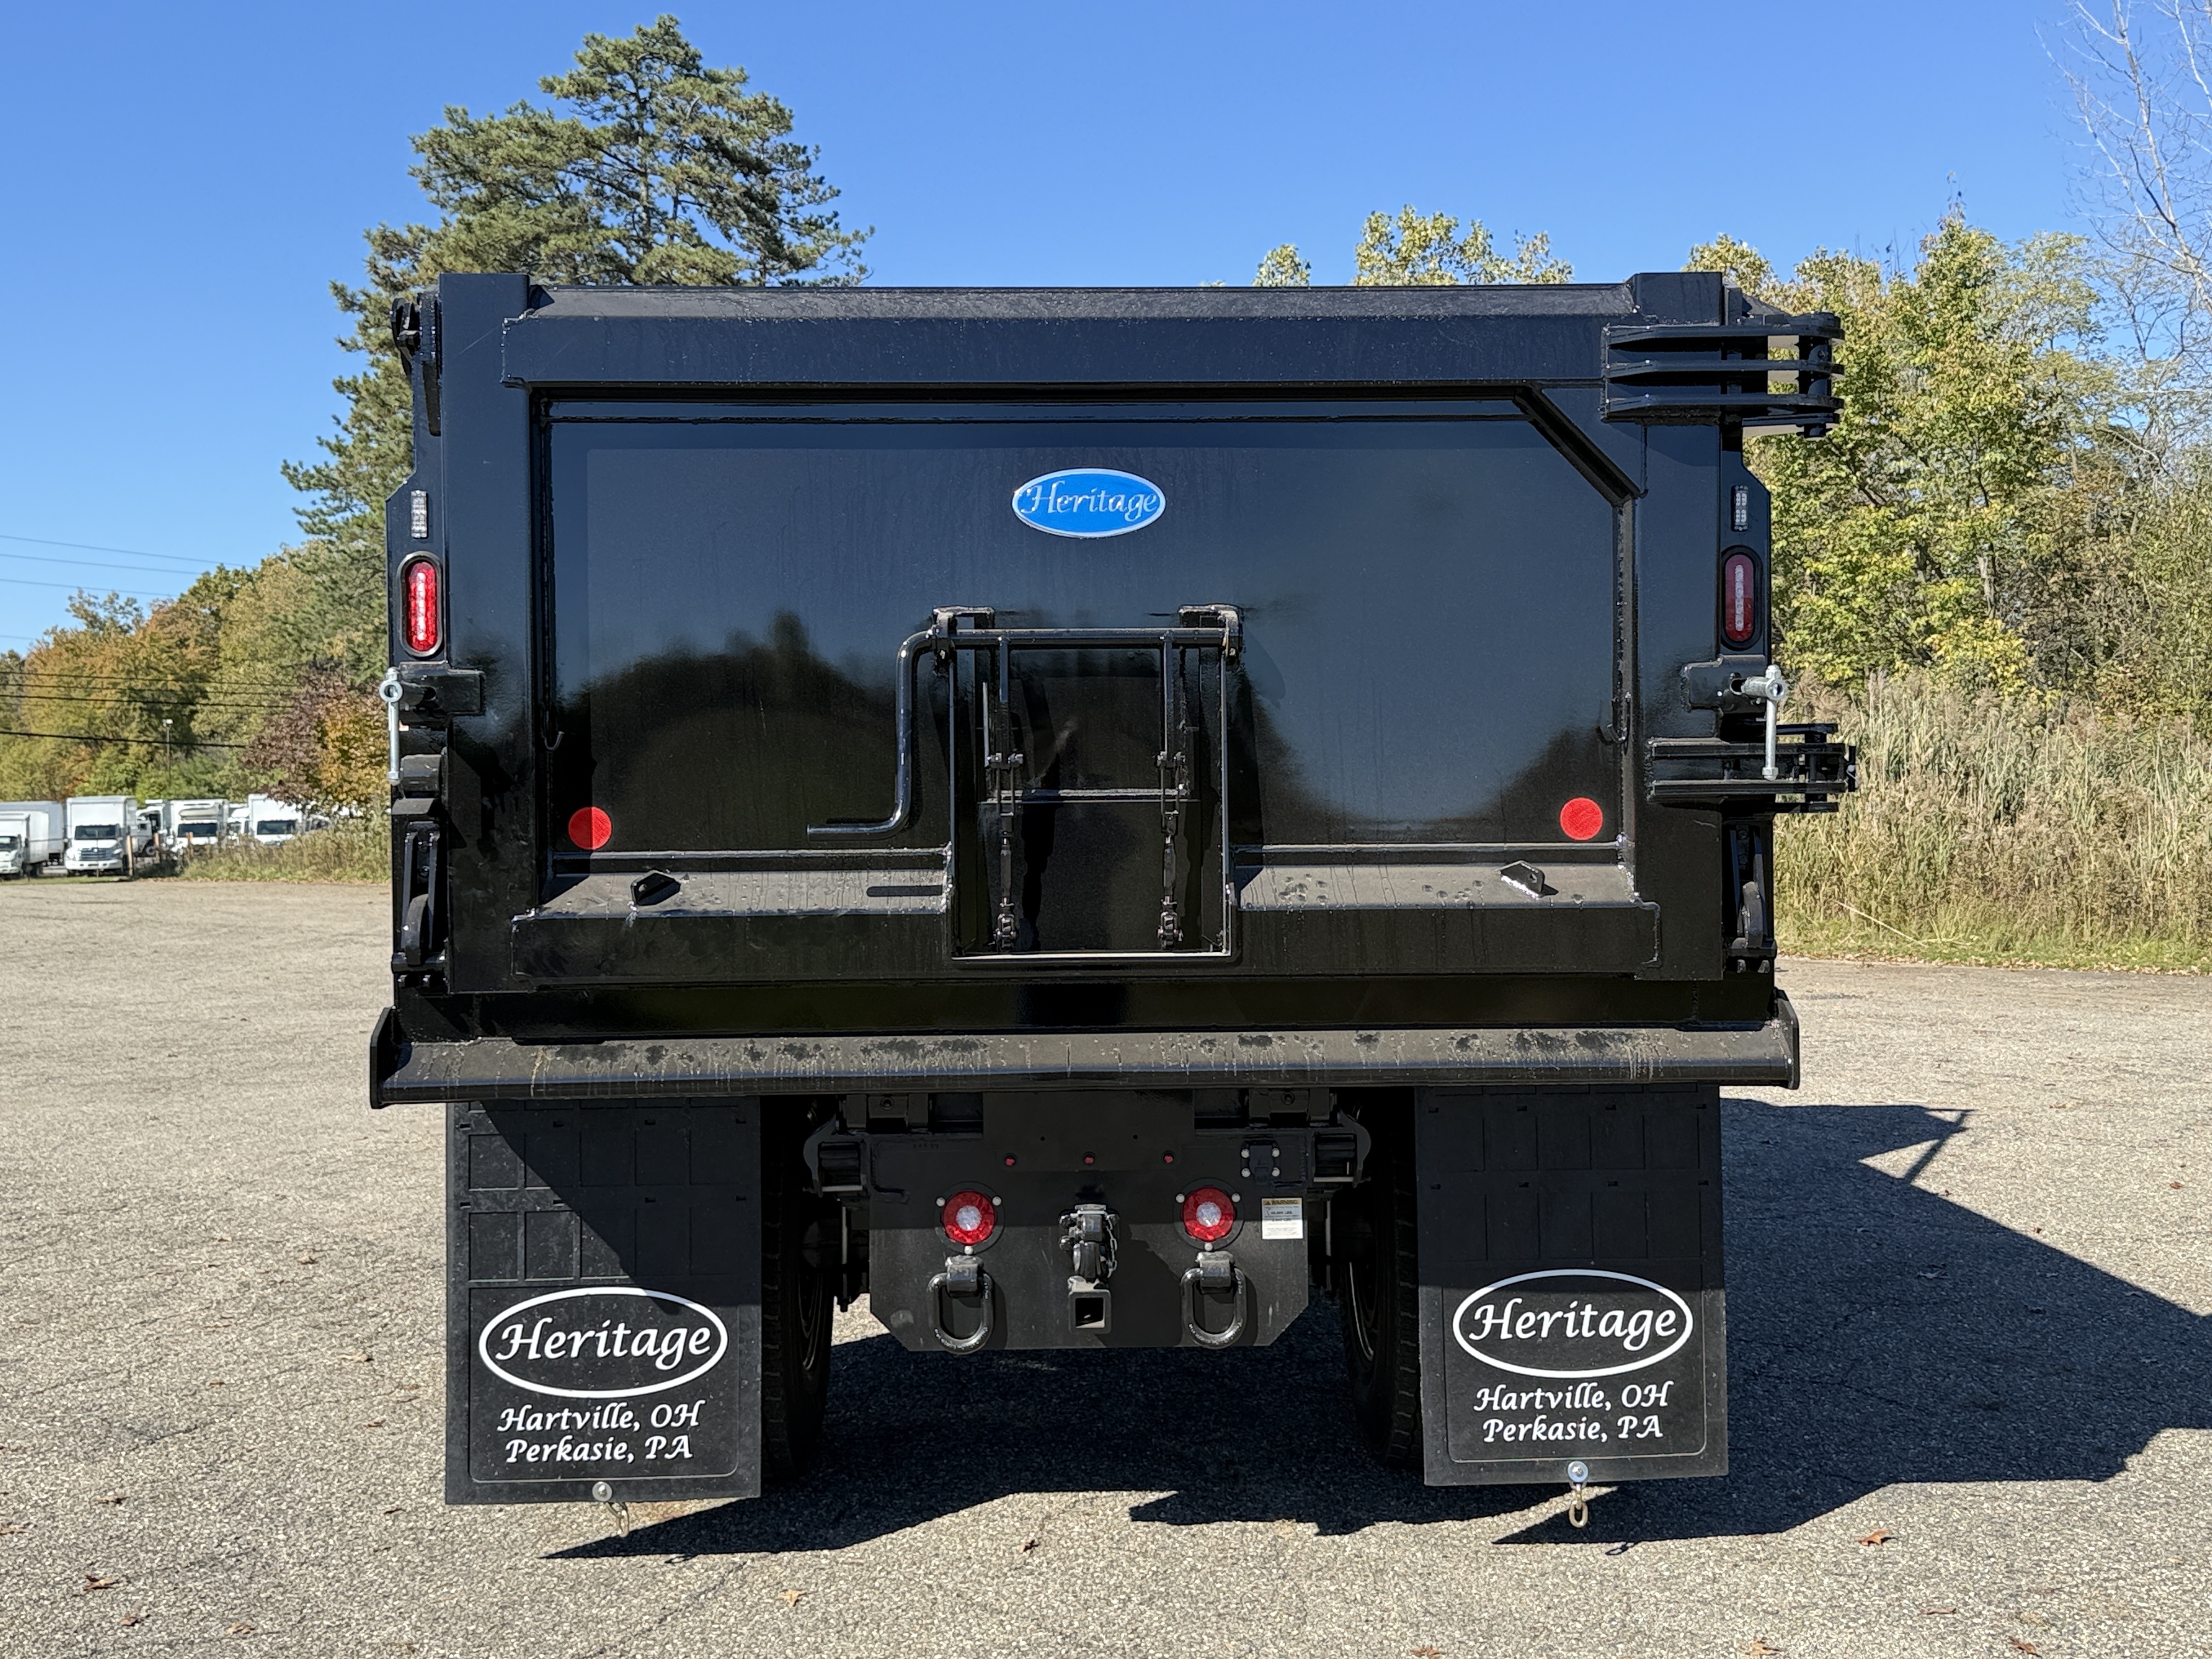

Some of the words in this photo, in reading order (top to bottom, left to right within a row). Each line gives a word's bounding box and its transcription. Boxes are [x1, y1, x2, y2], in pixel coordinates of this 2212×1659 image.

[1020, 479, 1157, 522] Heritage
[1469, 1297, 1677, 1351] Heritage
[495, 1317, 711, 1370] Heritage
[1473, 1382, 1612, 1412] Hartville,
[1621, 1380, 1674, 1408] OH
[496, 1402, 641, 1432] Hartville,
[651, 1400, 706, 1429] OH
[1482, 1414, 1608, 1443] Perkasie,
[1617, 1414, 1663, 1440] PA
[505, 1435, 635, 1464] Perkasie,
[645, 1434, 693, 1460] PA
